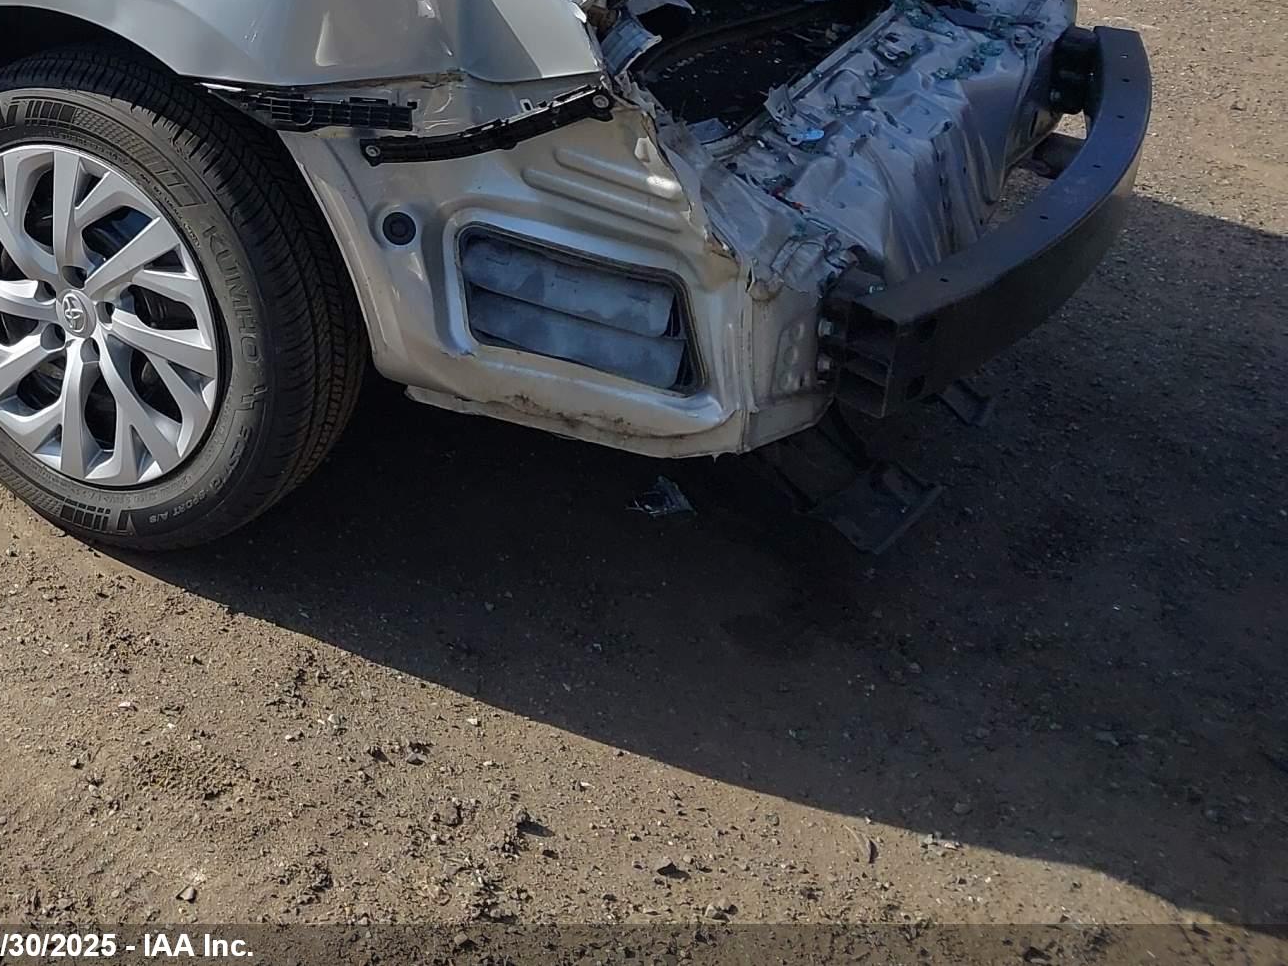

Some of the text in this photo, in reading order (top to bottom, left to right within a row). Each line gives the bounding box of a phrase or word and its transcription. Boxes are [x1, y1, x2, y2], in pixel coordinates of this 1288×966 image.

[202, 225, 264, 364] KUMHO
[172, 490, 208, 517] SPORT
[148, 512, 170, 524] A/S
